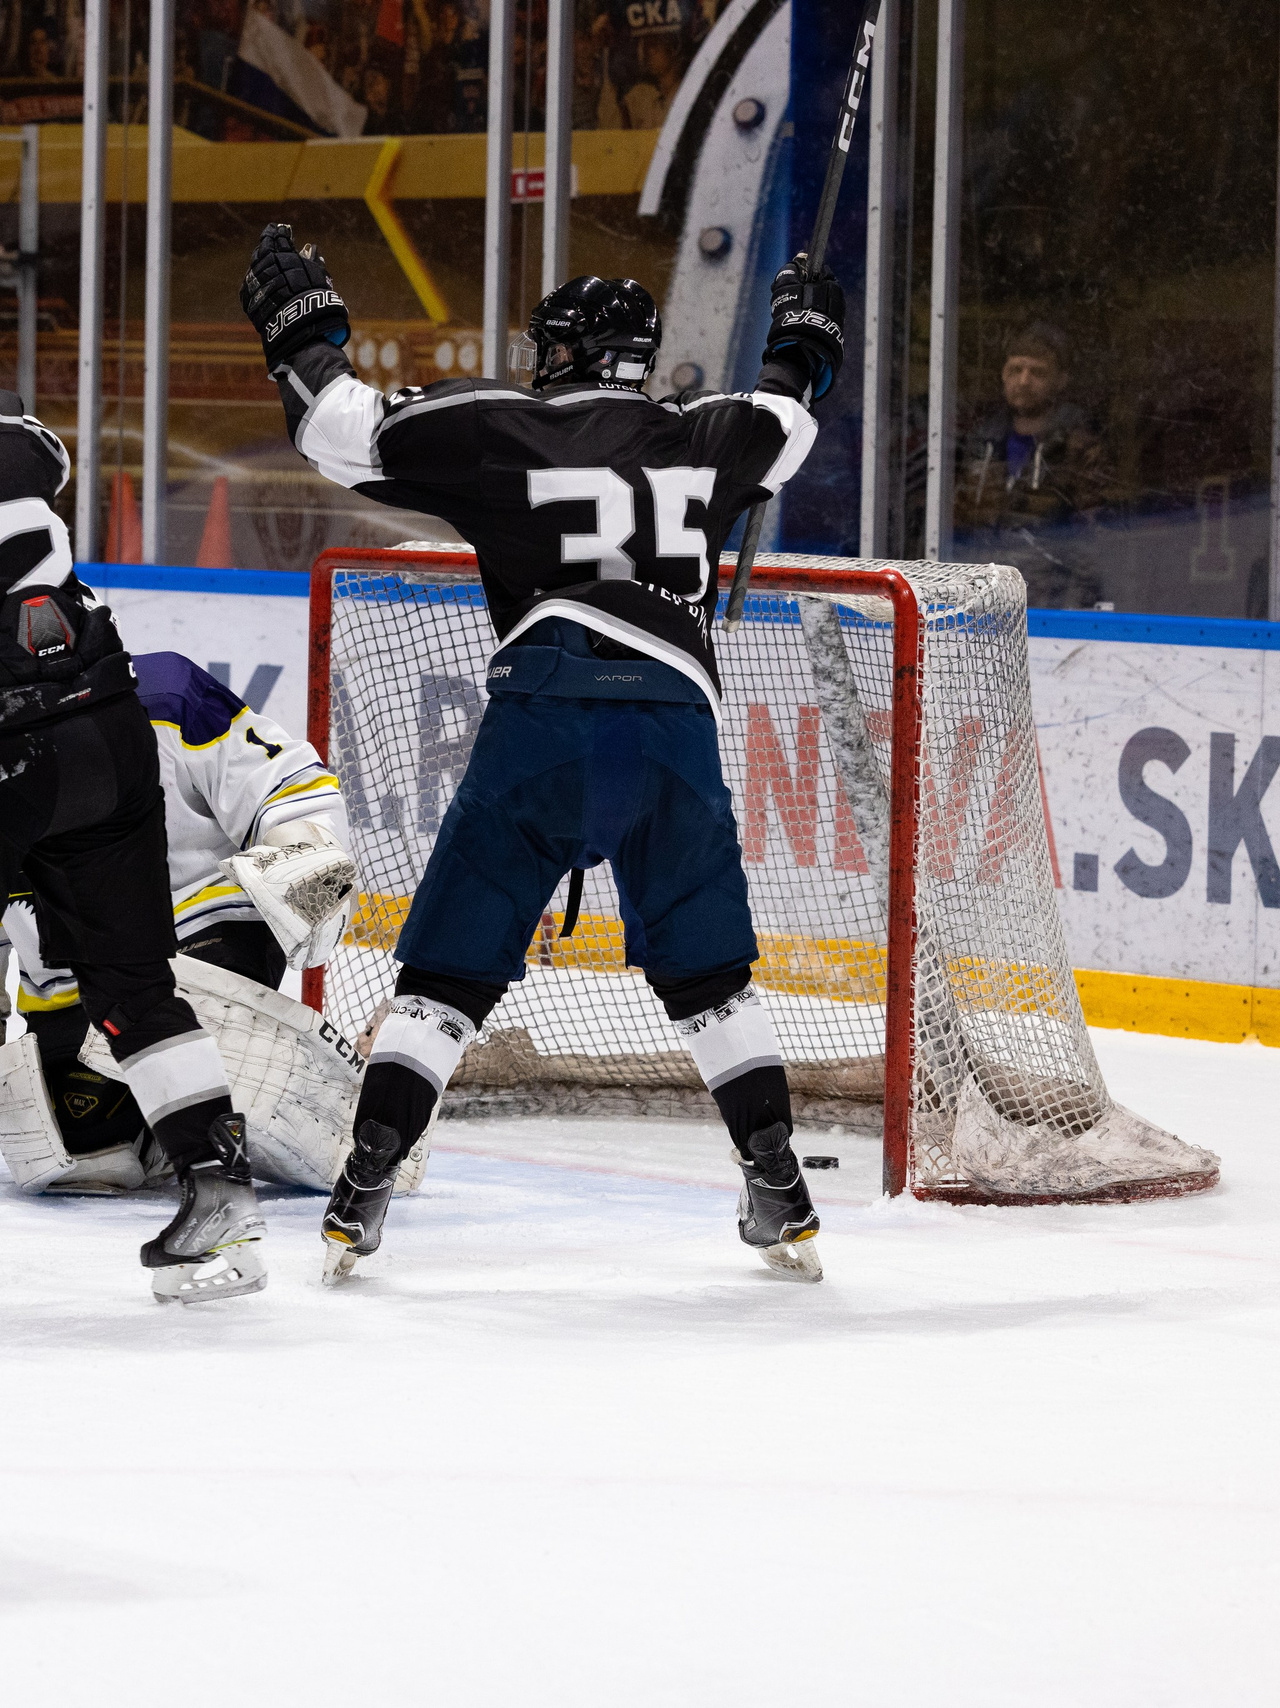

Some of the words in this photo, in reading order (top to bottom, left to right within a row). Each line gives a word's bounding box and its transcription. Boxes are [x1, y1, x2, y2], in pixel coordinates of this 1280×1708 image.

[838, 20, 876, 153] CCM
[546, 319, 571, 327] BAUER
[526, 465, 718, 604] 35
[38, 643, 65, 657] CCM
[594, 673, 644, 683] VAPOR
[245, 726, 284, 760] 1
[319, 1018, 366, 1074] CCM
[73, 1098, 86, 1108] MAX
